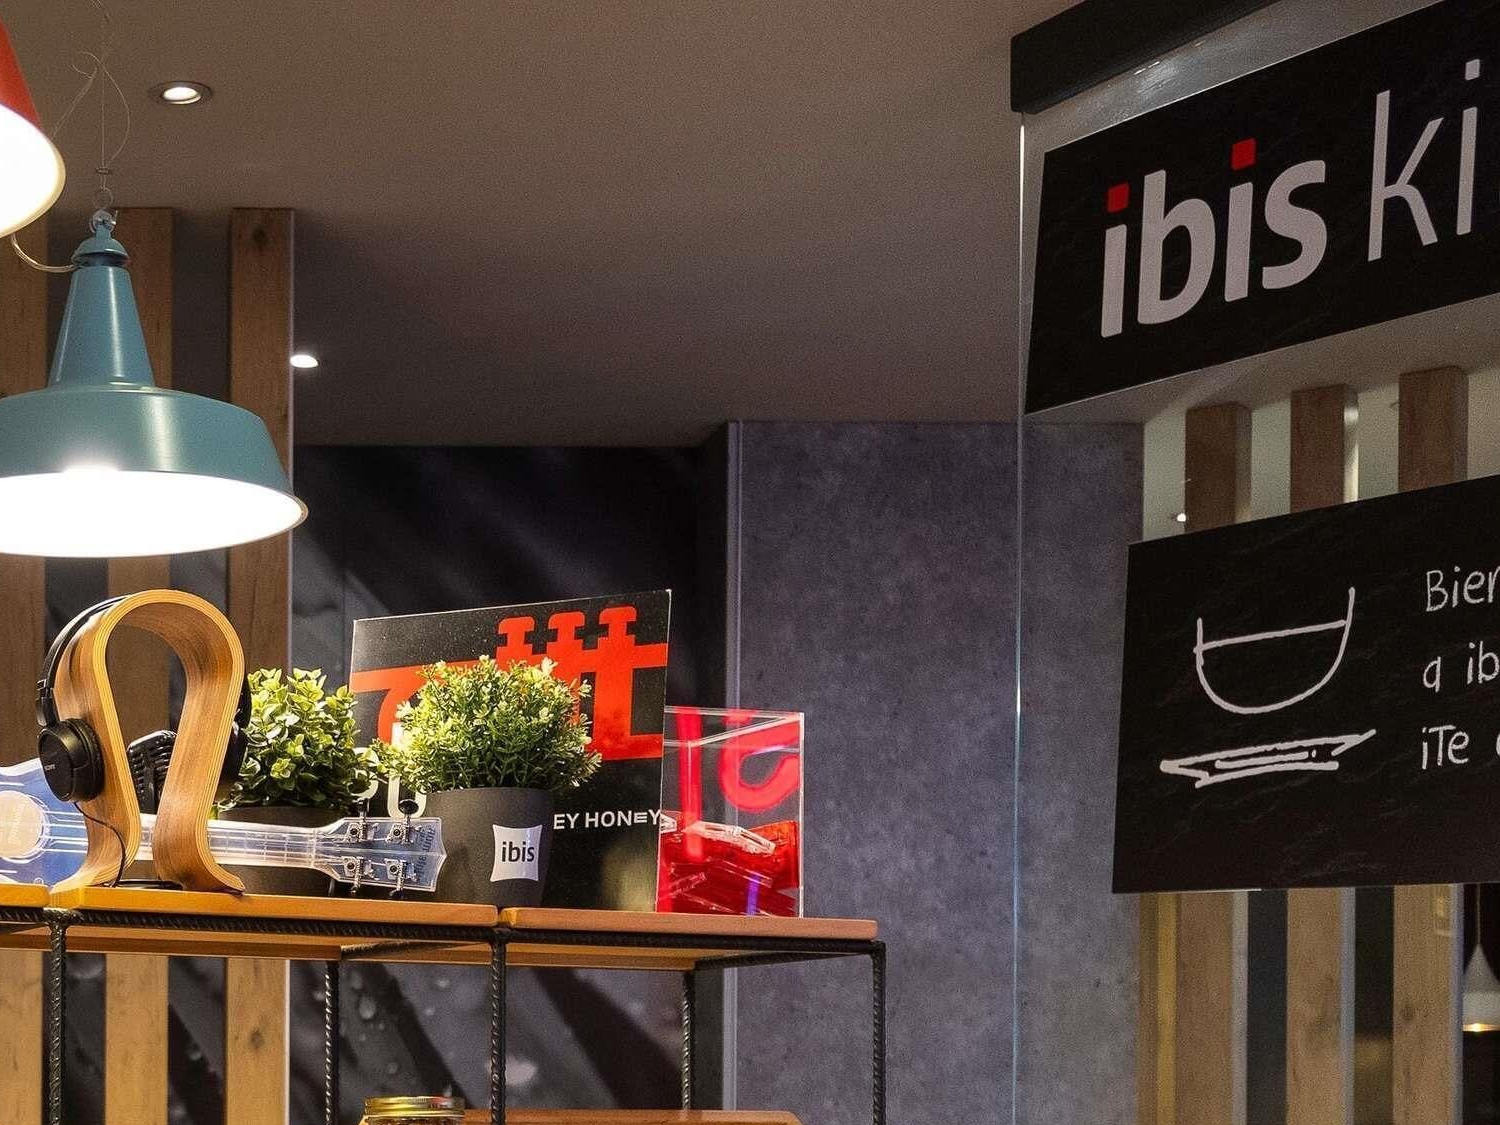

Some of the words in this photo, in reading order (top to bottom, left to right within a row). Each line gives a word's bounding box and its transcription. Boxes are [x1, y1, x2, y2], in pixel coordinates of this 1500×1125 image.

[1101, 137, 1328, 338] ibis
[1368, 59, 1481, 262] ki
[585, 809, 660, 828] HONEY
[501, 841, 535, 863] ibis
